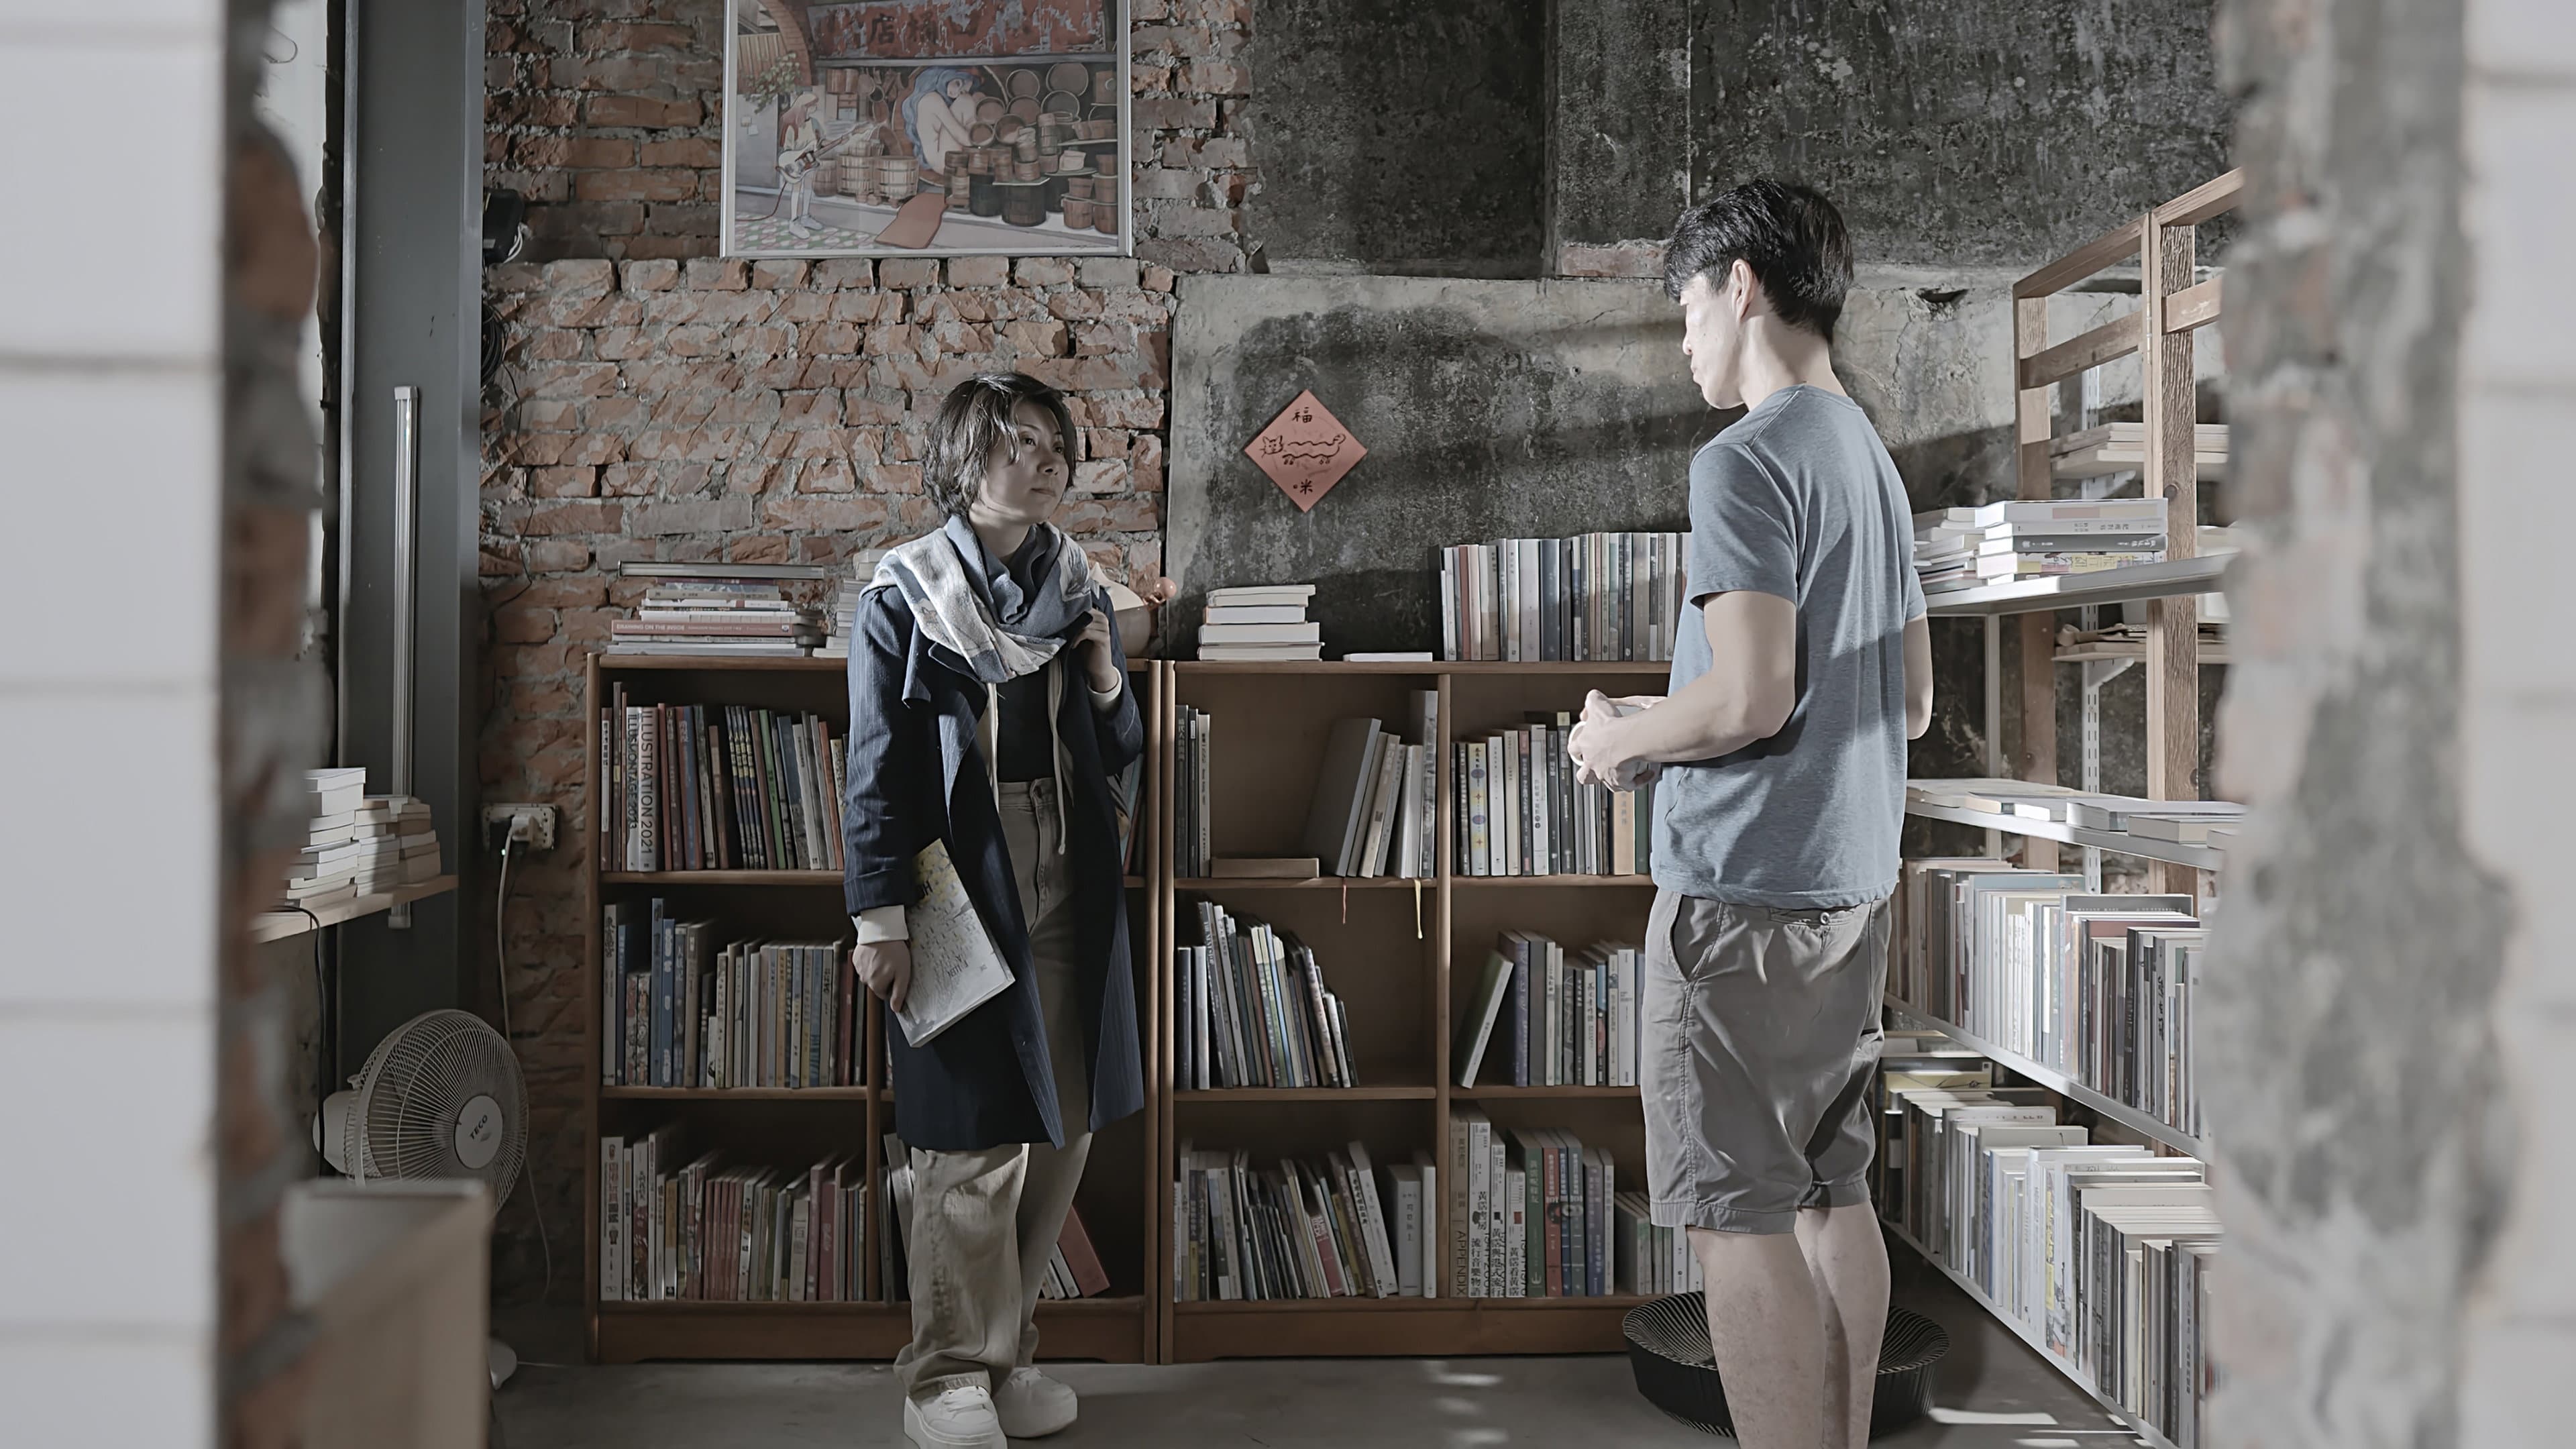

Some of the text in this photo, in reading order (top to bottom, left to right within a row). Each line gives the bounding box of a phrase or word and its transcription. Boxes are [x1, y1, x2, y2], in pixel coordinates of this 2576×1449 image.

[1292, 407, 1313, 423] 福
[641, 710, 653, 854] ILLUSTRATION 2021
[471, 1115, 488, 1139] TECO
[1456, 1230, 1466, 1295] APPENDIX
